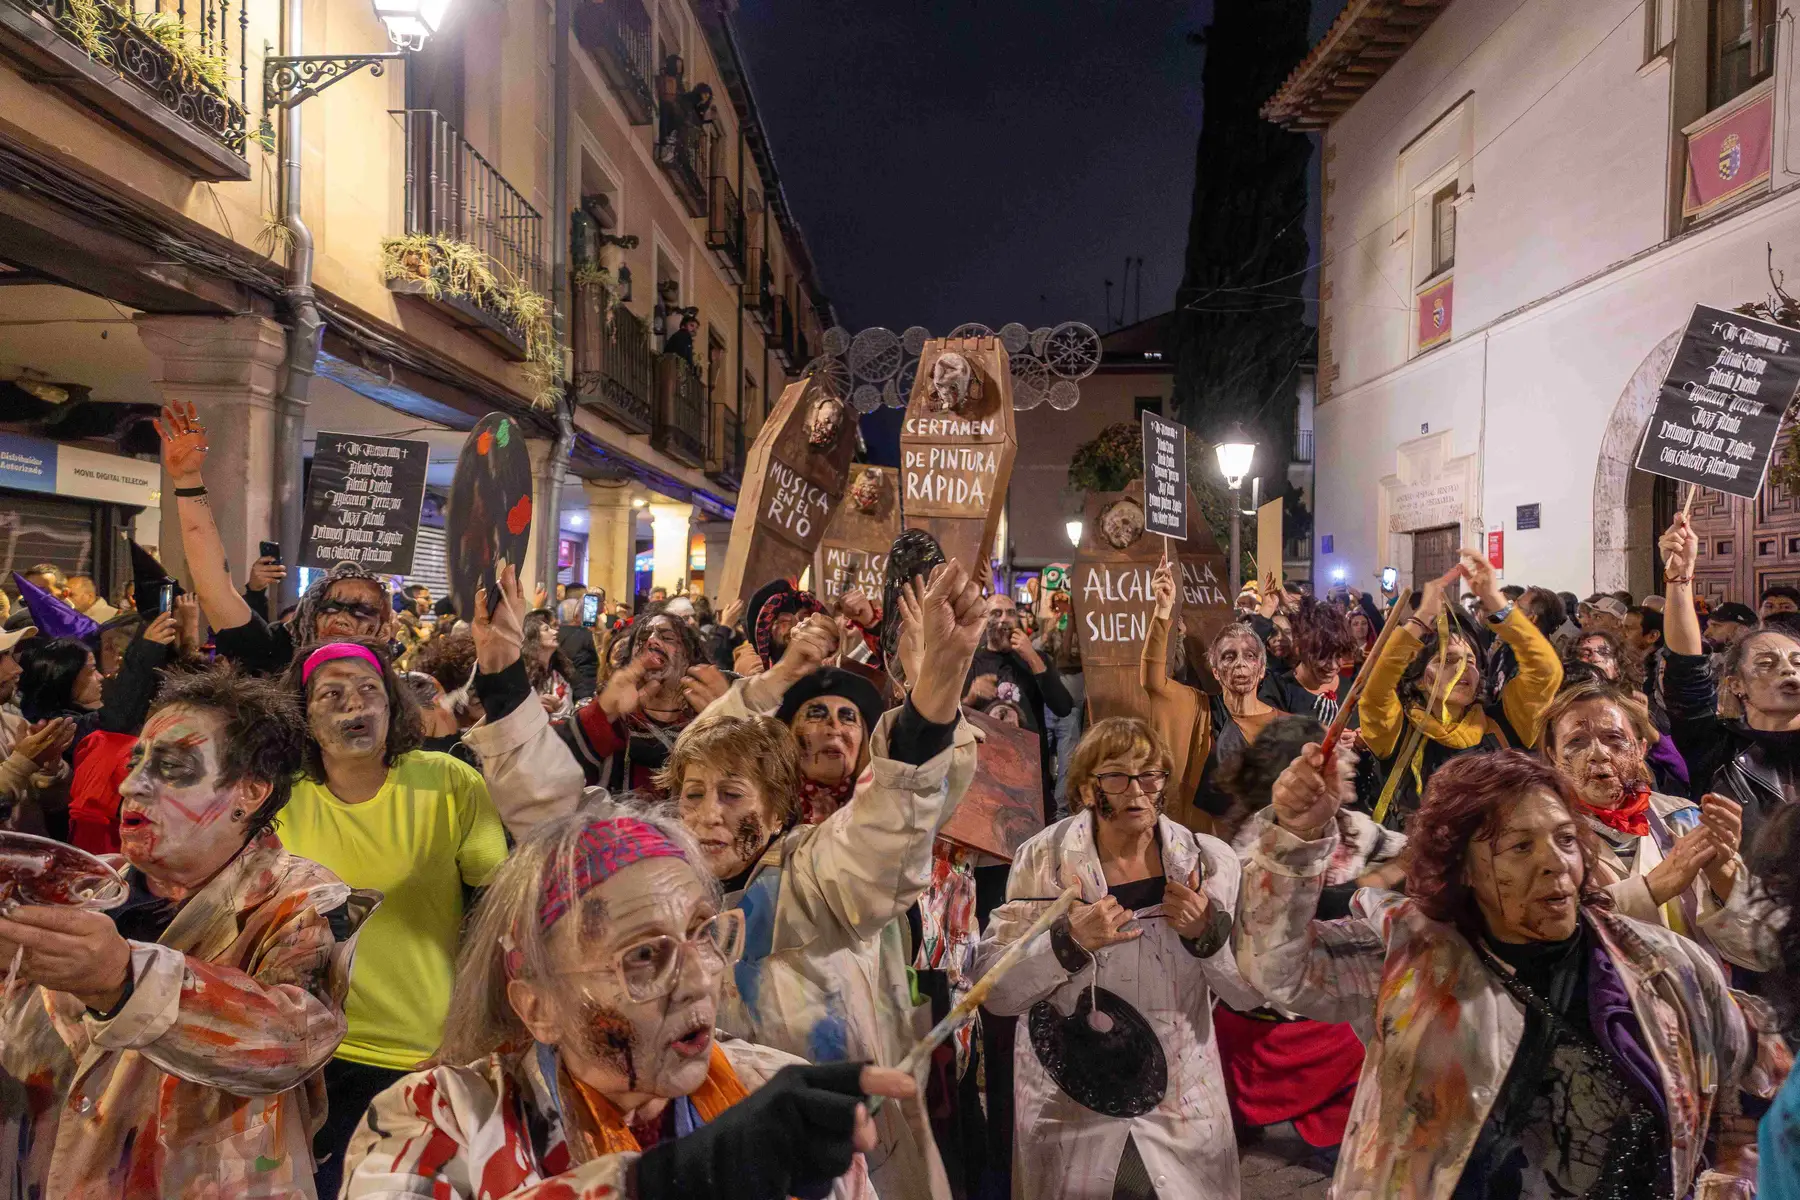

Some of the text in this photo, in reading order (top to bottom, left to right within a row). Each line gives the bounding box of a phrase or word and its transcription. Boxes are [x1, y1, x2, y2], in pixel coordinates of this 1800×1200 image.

[906, 418, 994, 436] CERTAMEN
[906, 448, 996, 473] DE PINTURA
[96, 471, 120, 483] DIGITAL
[121, 476, 149, 487] TELECOM
[769, 461, 829, 515] MÚSICA
[907, 469, 986, 505] RÁPIDA
[777, 489, 809, 517] EN EL
[768, 498, 811, 537] RIO
[827, 549, 889, 572] MUIC
[1180, 561, 1219, 585] ALÁ
[859, 571, 883, 585] LAS
[1083, 567, 1158, 604] ALCAL
[1183, 585, 1228, 605] ENTA
[1085, 610, 1146, 642] SUEN
